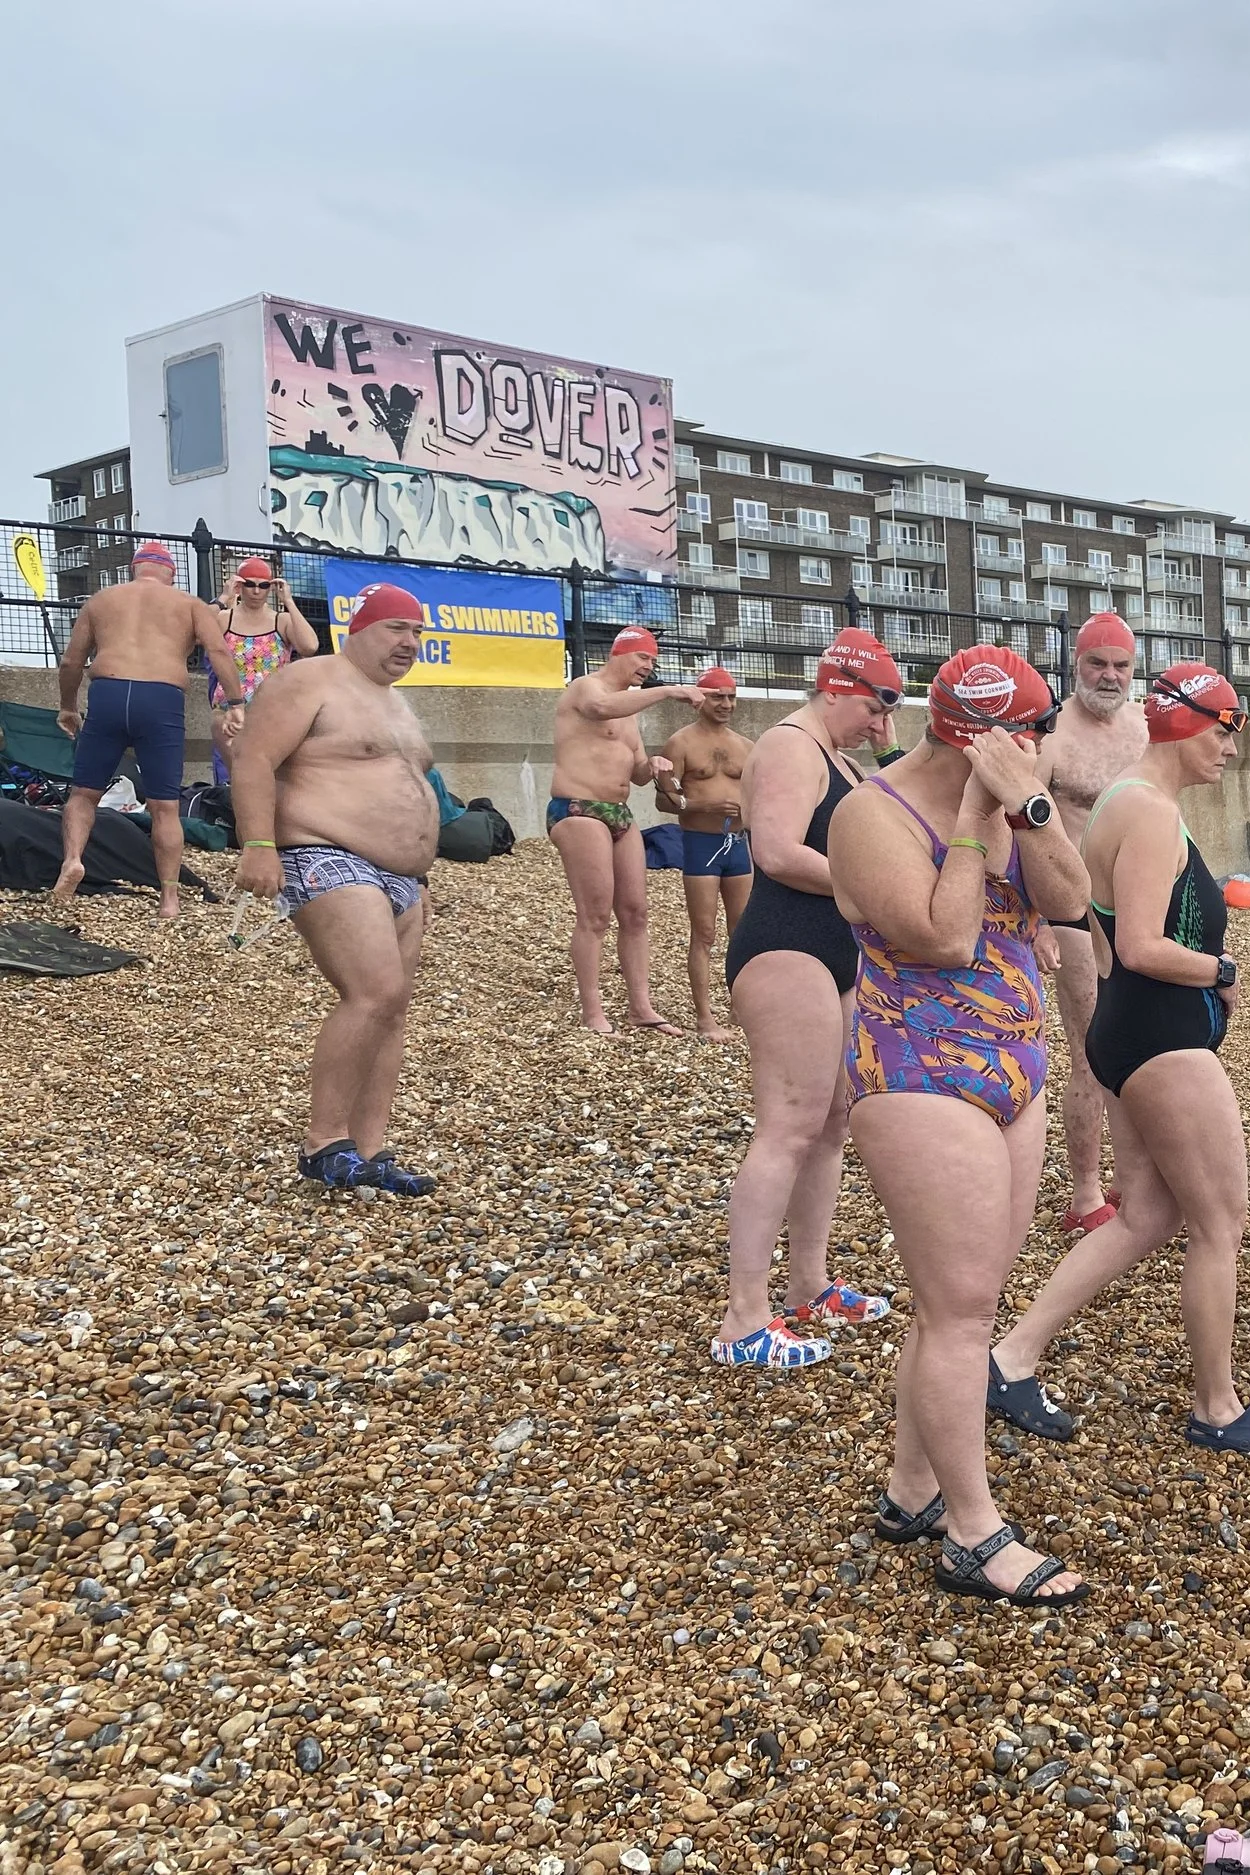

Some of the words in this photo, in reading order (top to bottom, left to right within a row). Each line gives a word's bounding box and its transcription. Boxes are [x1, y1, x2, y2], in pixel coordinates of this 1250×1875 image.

[273, 313, 376, 375] WE
[432, 349, 644, 480] DOVER
[437, 603, 560, 636] SWIMMERS
[416, 639, 451, 665] ACE
[828, 678, 854, 688] Kristen
